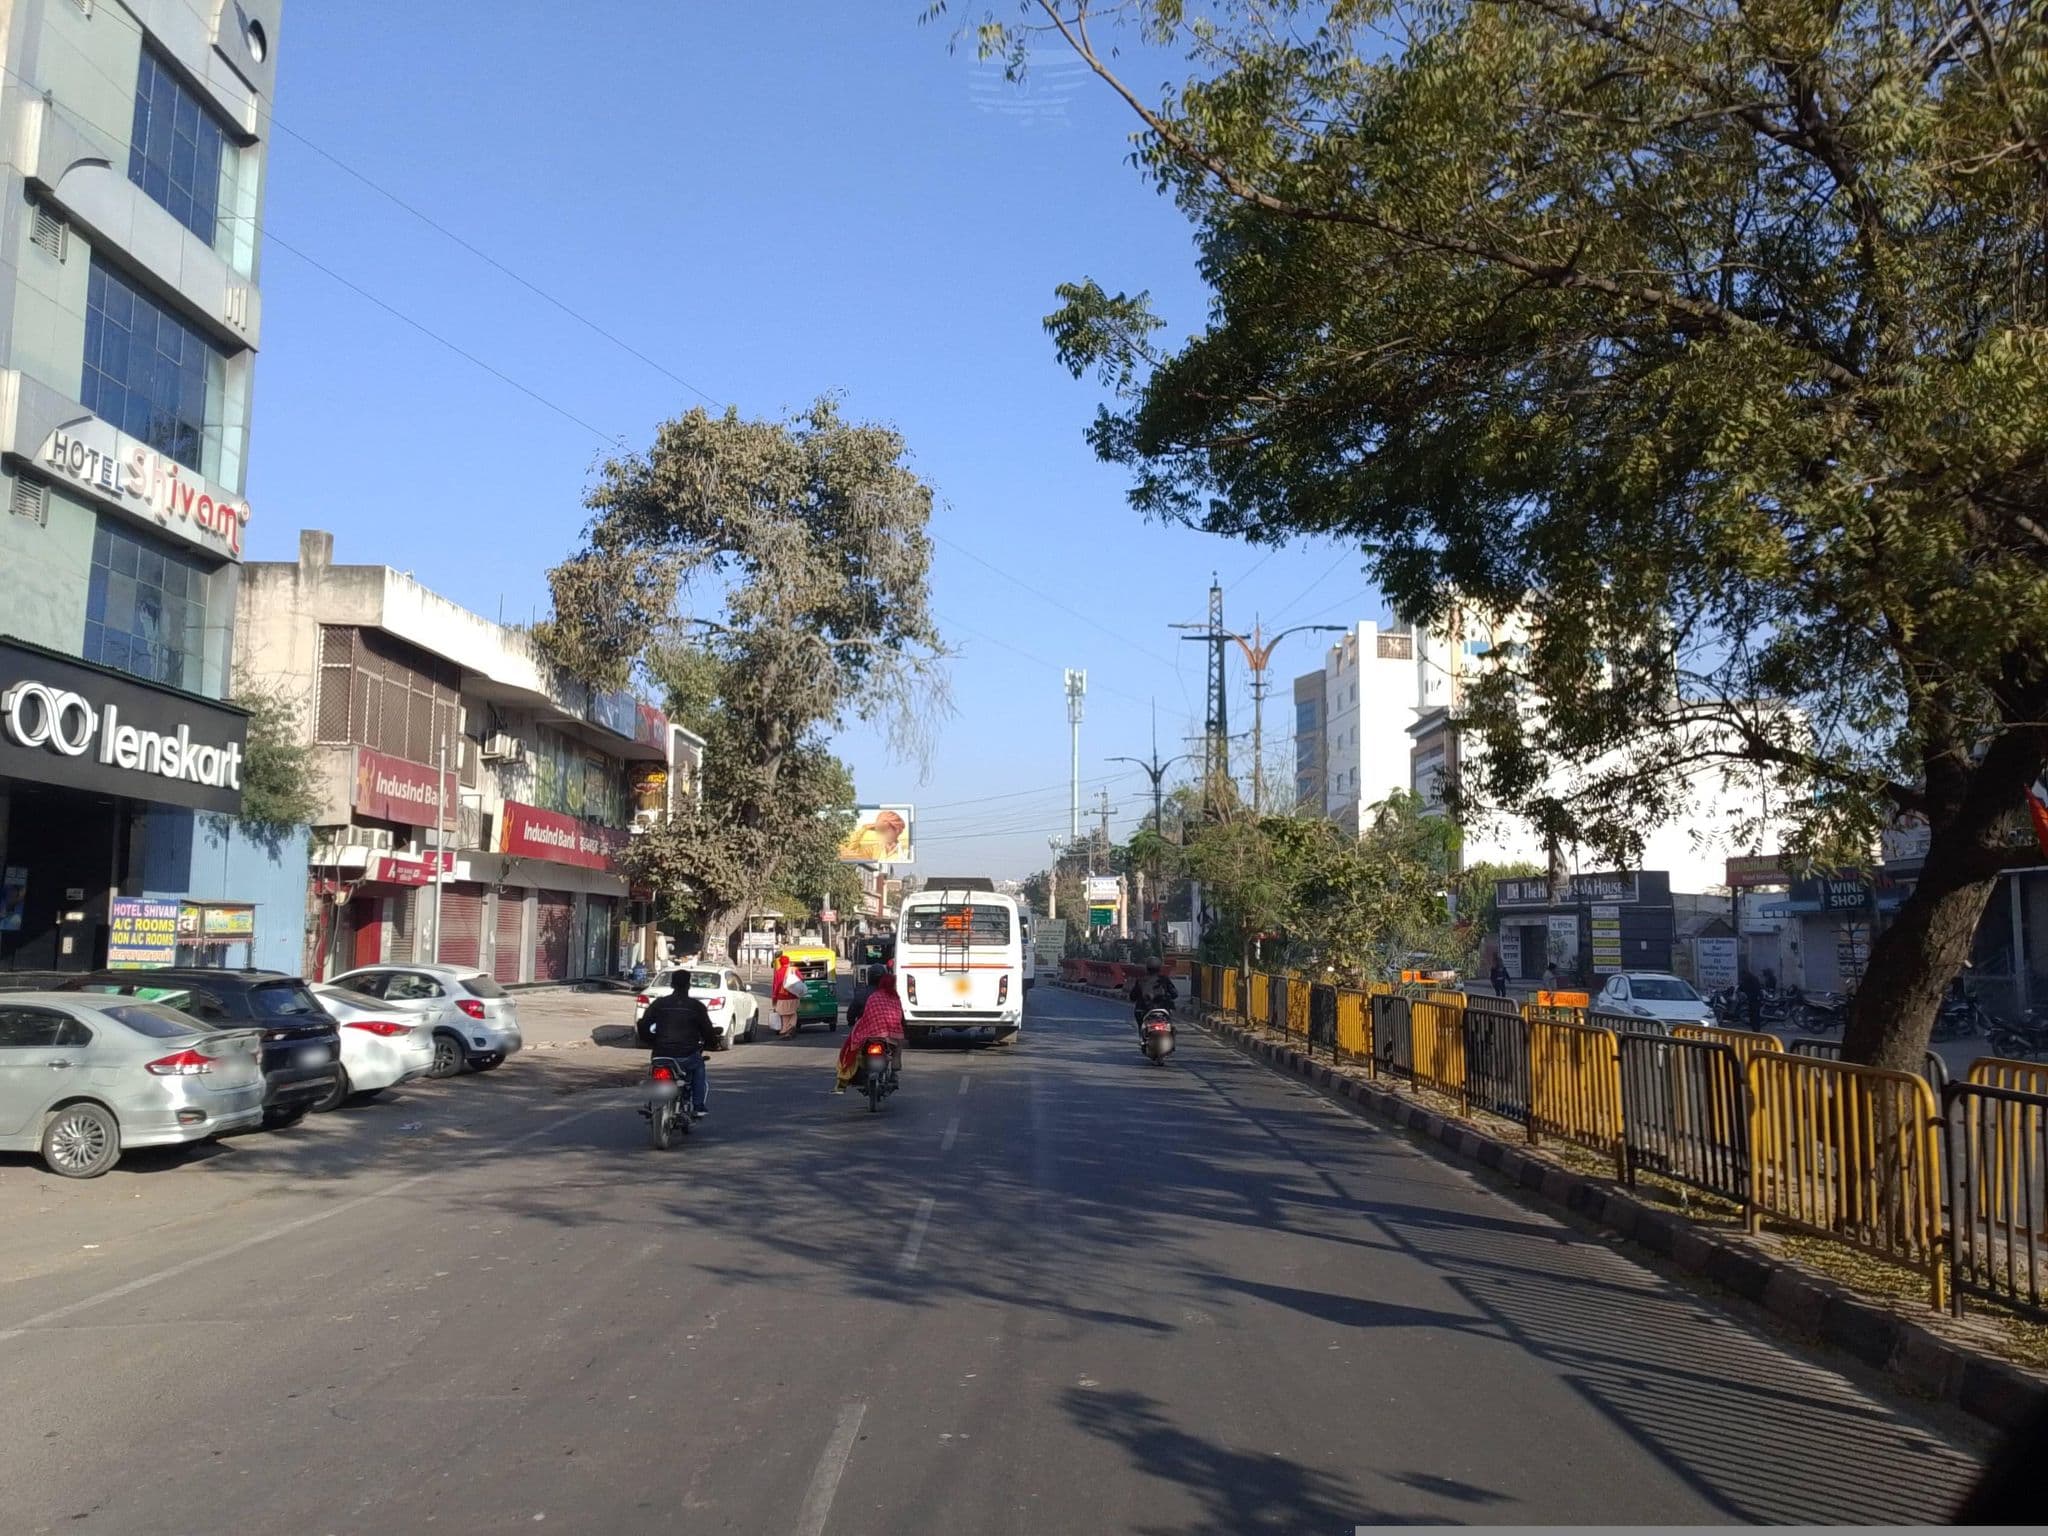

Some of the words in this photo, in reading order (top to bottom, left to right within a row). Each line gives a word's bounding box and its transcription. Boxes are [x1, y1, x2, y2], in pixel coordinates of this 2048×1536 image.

[53, 430, 124, 493] HOTEL
[125, 446, 240, 554] Shivam
[100, 703, 242, 790] lenskart
[376, 771, 425, 803] IndusInd
[425, 785, 449, 808] Bak
[523, 820, 558, 846] IndusInd
[558, 829, 576, 849] Bank
[1829, 881, 1865, 894] WINE
[1830, 894, 1865, 907] SHOP
[113, 903, 142, 917] HOTEL
[143, 904, 177, 918] SHIVAM
[113, 918, 132, 931] A/C
[135, 919, 175, 932] ROOMS
[112, 931, 128, 945] NON
[130, 933, 144, 945] A/C
[145, 933, 174, 946] ROOMS
